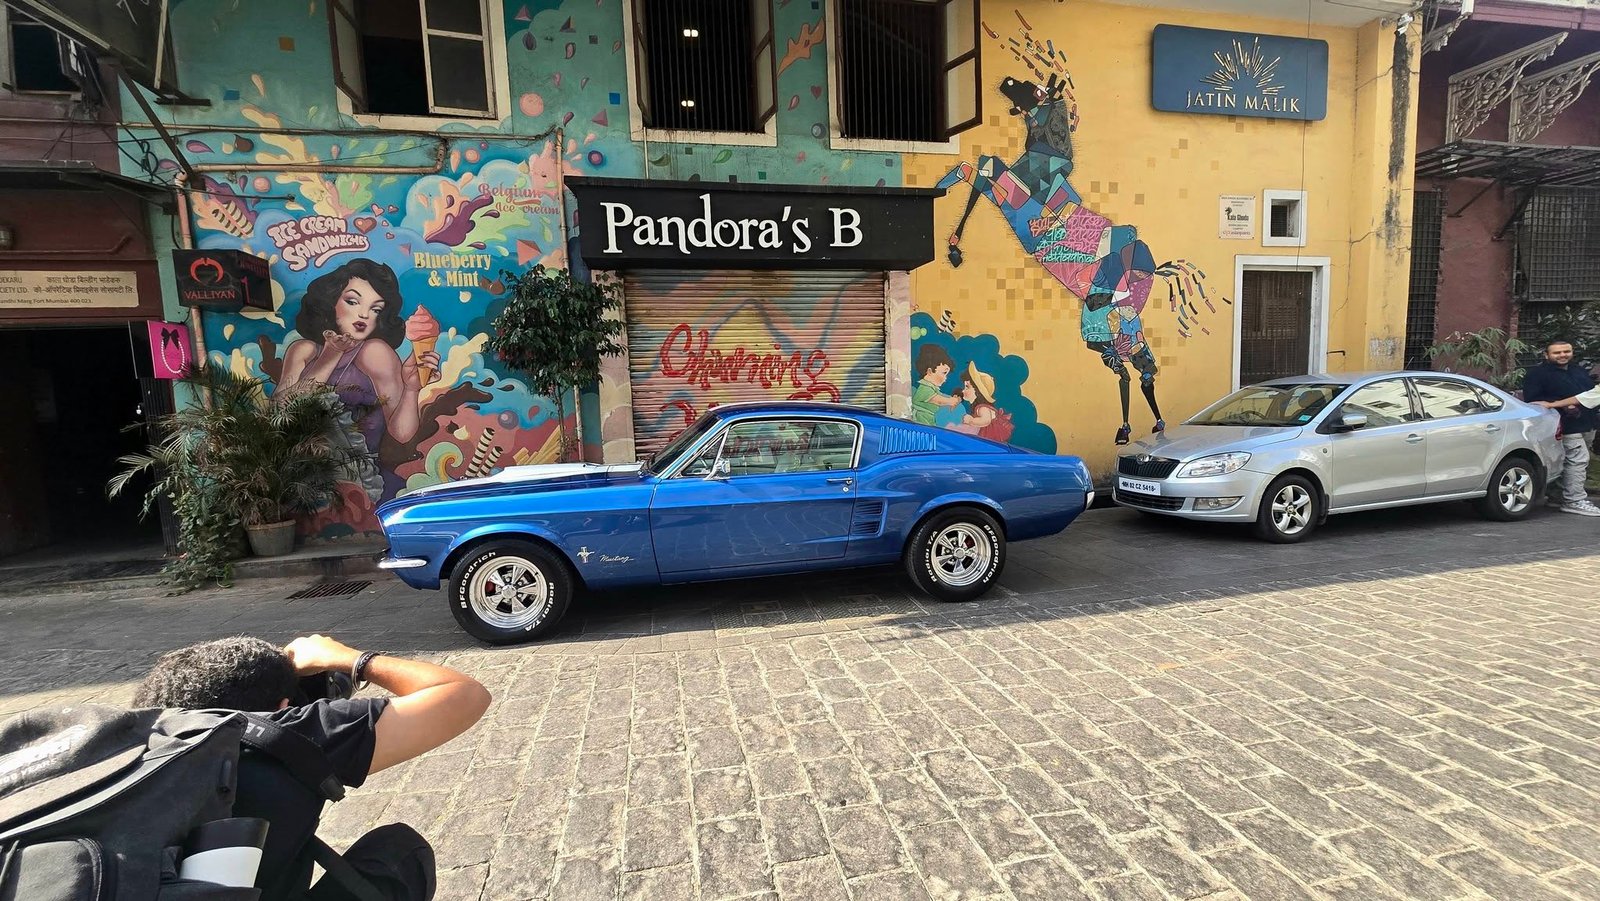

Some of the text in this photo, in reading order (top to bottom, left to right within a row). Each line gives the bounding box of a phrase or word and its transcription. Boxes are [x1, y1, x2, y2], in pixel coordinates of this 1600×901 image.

[1186, 91, 1300, 113] JATIN MALIK
[478, 182, 542, 204] Belgium
[495, 202, 560, 215] Ice cream
[267, 216, 346, 247] ICE CREAM
[600, 193, 863, 254] Pandora's B
[413, 252, 491, 270] Blueberry
[428, 270, 479, 287] & Mint
[184, 290, 235, 299] VALLIYAN
[599, 554, 634, 564] Mustang
[983, 524, 999, 583] BFGoodrich
[925, 548, 938, 582] Radial
[459, 551, 496, 609] BFGoodrich
[524, 582, 555, 632] Radial T/A
